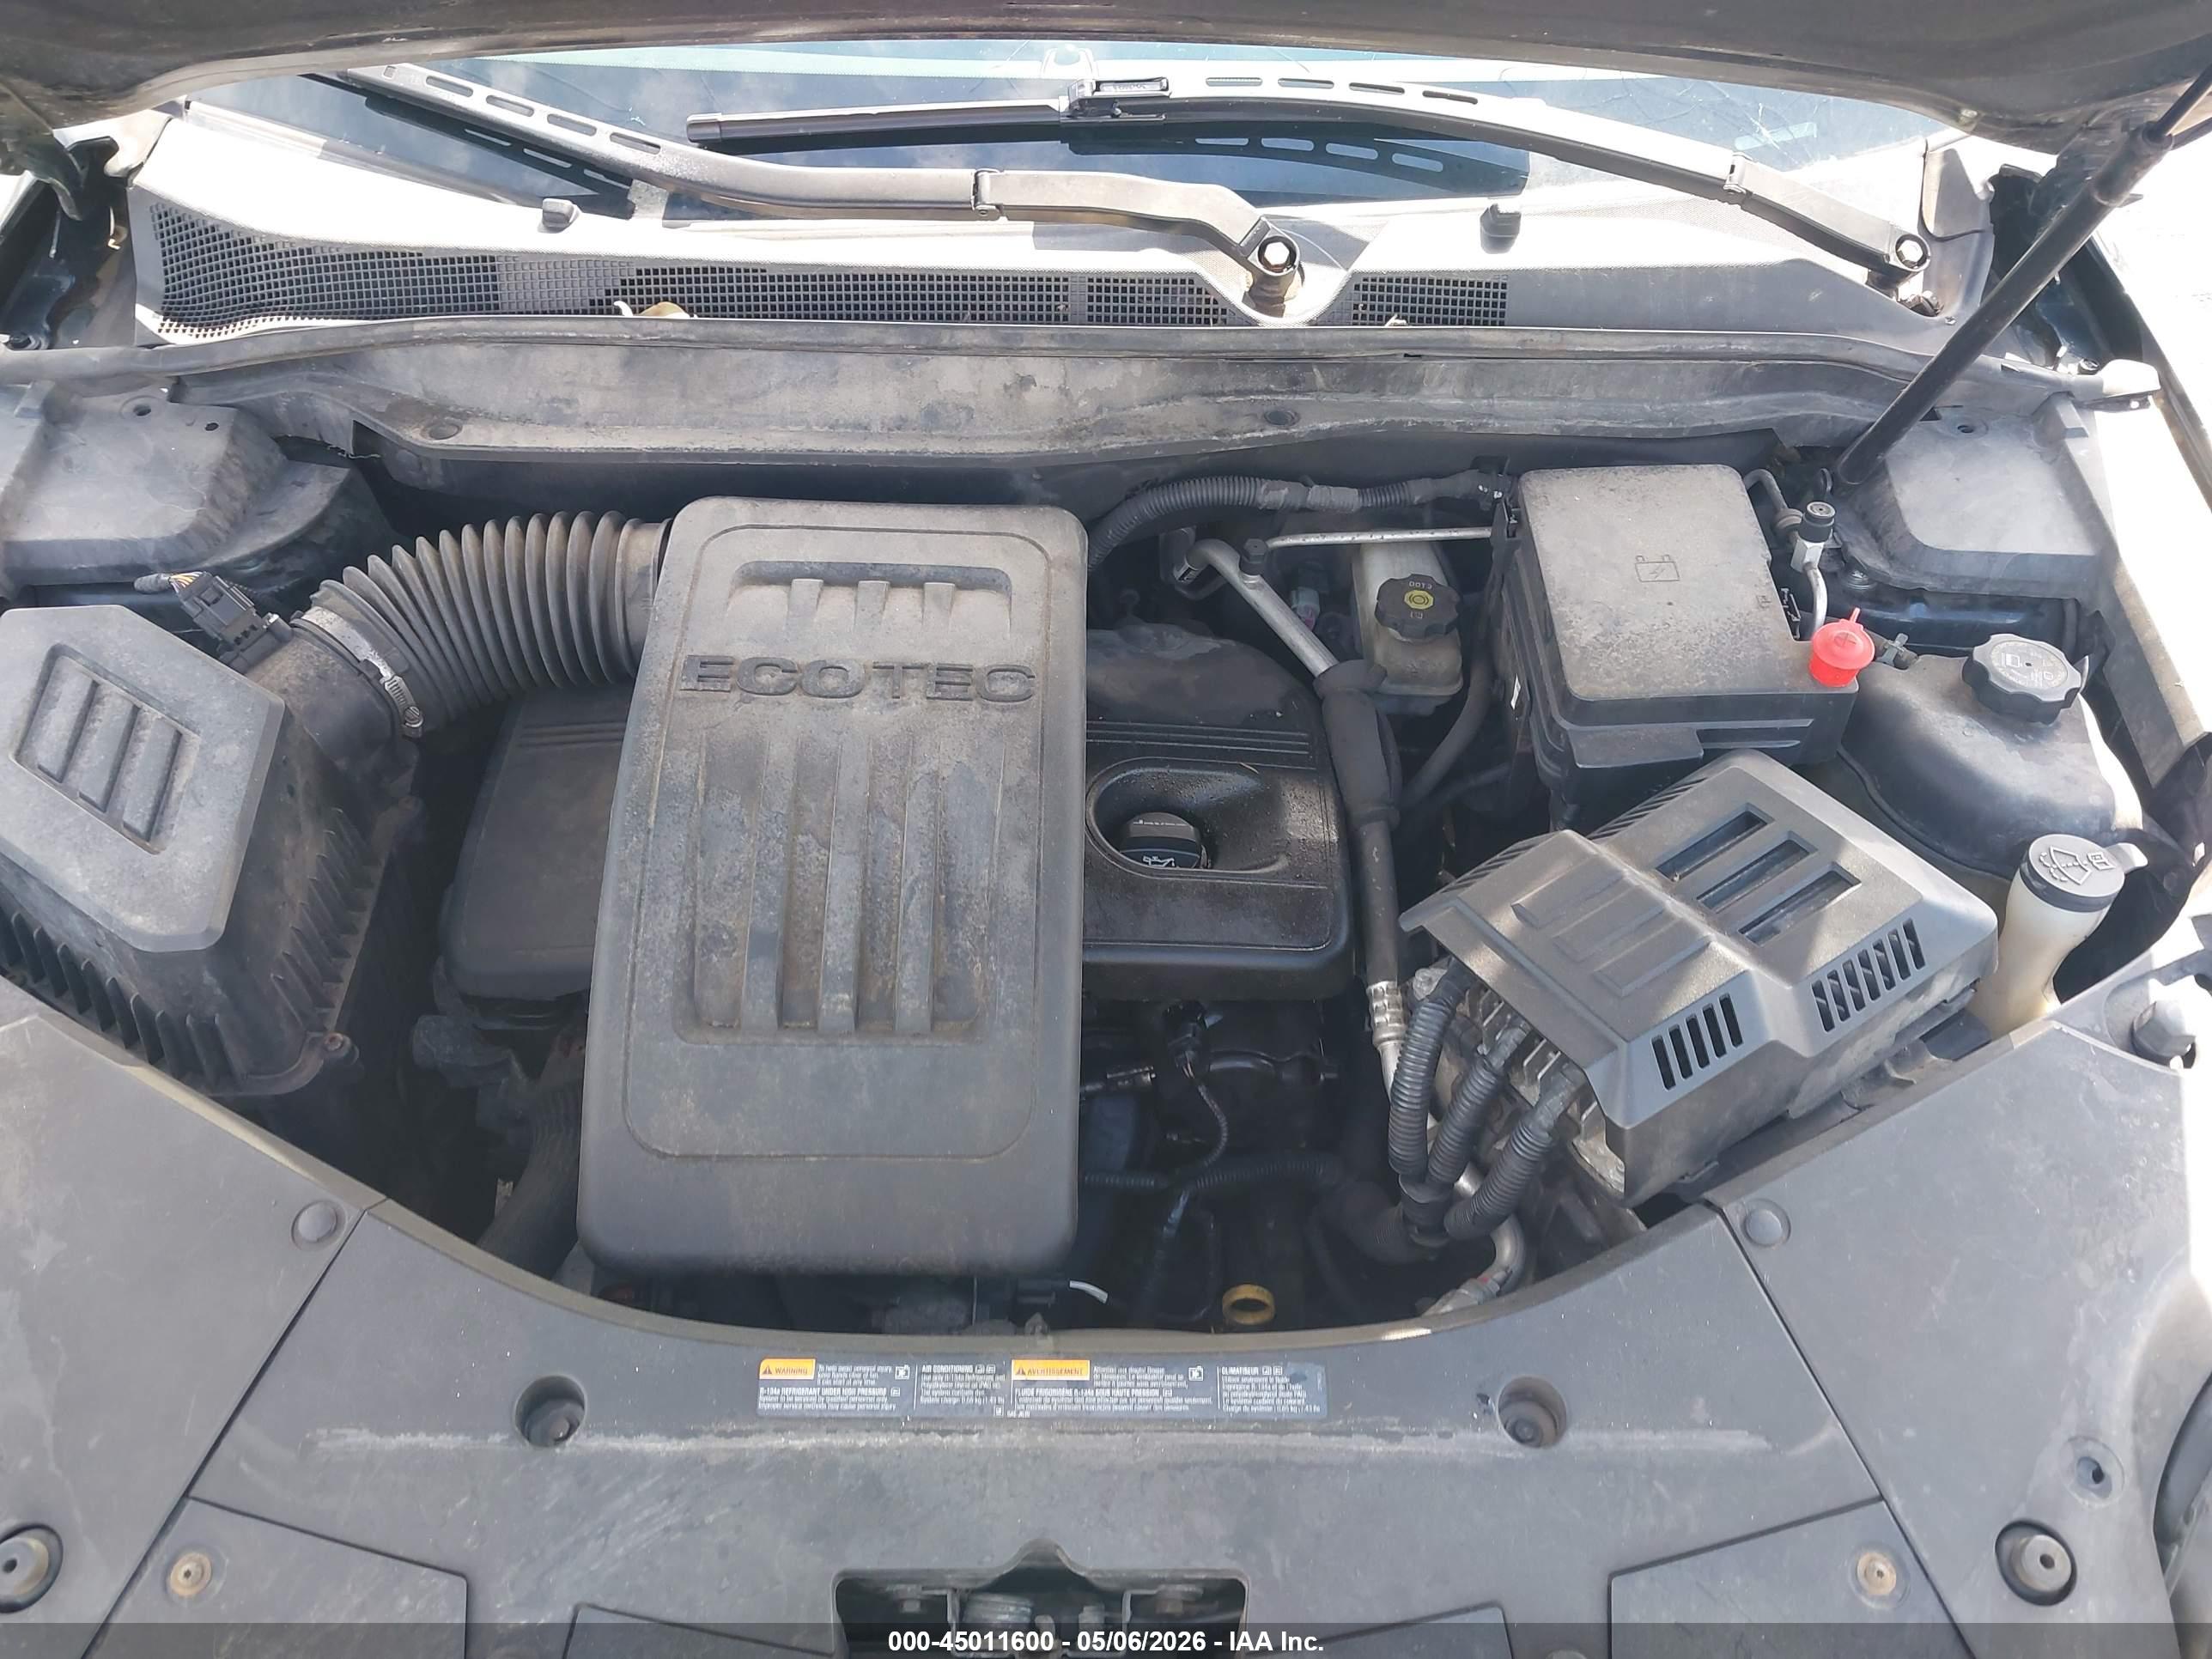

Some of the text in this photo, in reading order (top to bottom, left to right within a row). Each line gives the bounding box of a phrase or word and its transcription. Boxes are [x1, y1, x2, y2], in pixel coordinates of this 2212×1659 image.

[680, 654, 1036, 703] ECOTEC
[775, 1367, 808, 1376] WARNING
[921, 1364, 974, 1374] AIR CONDITIONING
[1027, 1367, 1083, 1376] AVERTISSEMENT
[1221, 1366, 1259, 1375] CLIMATISEUR
